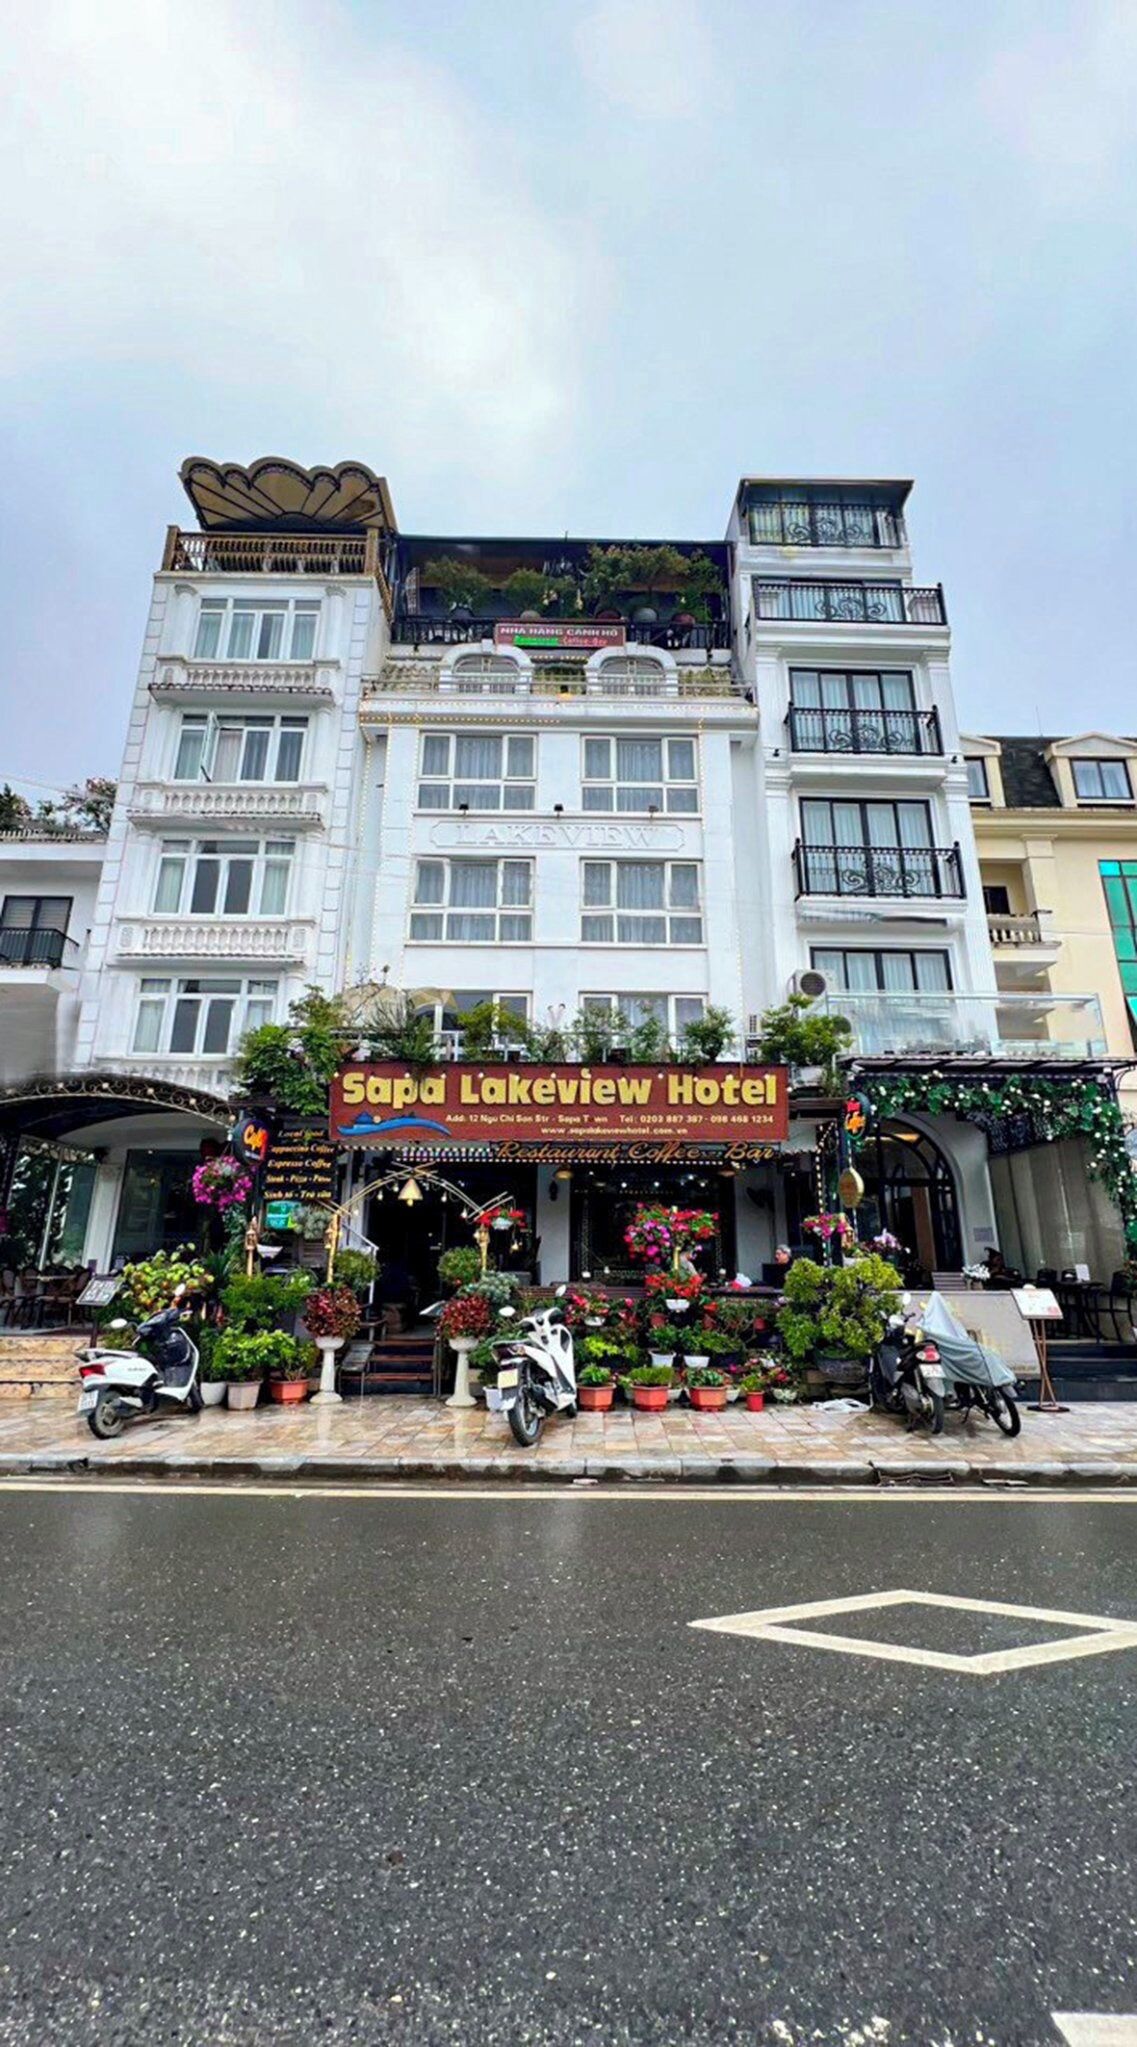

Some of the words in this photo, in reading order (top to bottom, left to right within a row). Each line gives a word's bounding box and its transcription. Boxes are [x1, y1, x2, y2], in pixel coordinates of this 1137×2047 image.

[455, 825, 659, 847] LAKEVIEW
[342, 1071, 447, 1108] Sapa
[460, 1067, 652, 1105] Lakeview
[668, 1073, 777, 1105] Hotel
[469, 1114, 479, 1122] 12
[751, 1114, 774, 1123] 1234
[496, 1140, 621, 1160] Restaurant
[627, 1139, 701, 1163] Coffee
[724, 1140, 775, 1160] Bar
[304, 1158, 332, 1168] Coffee
